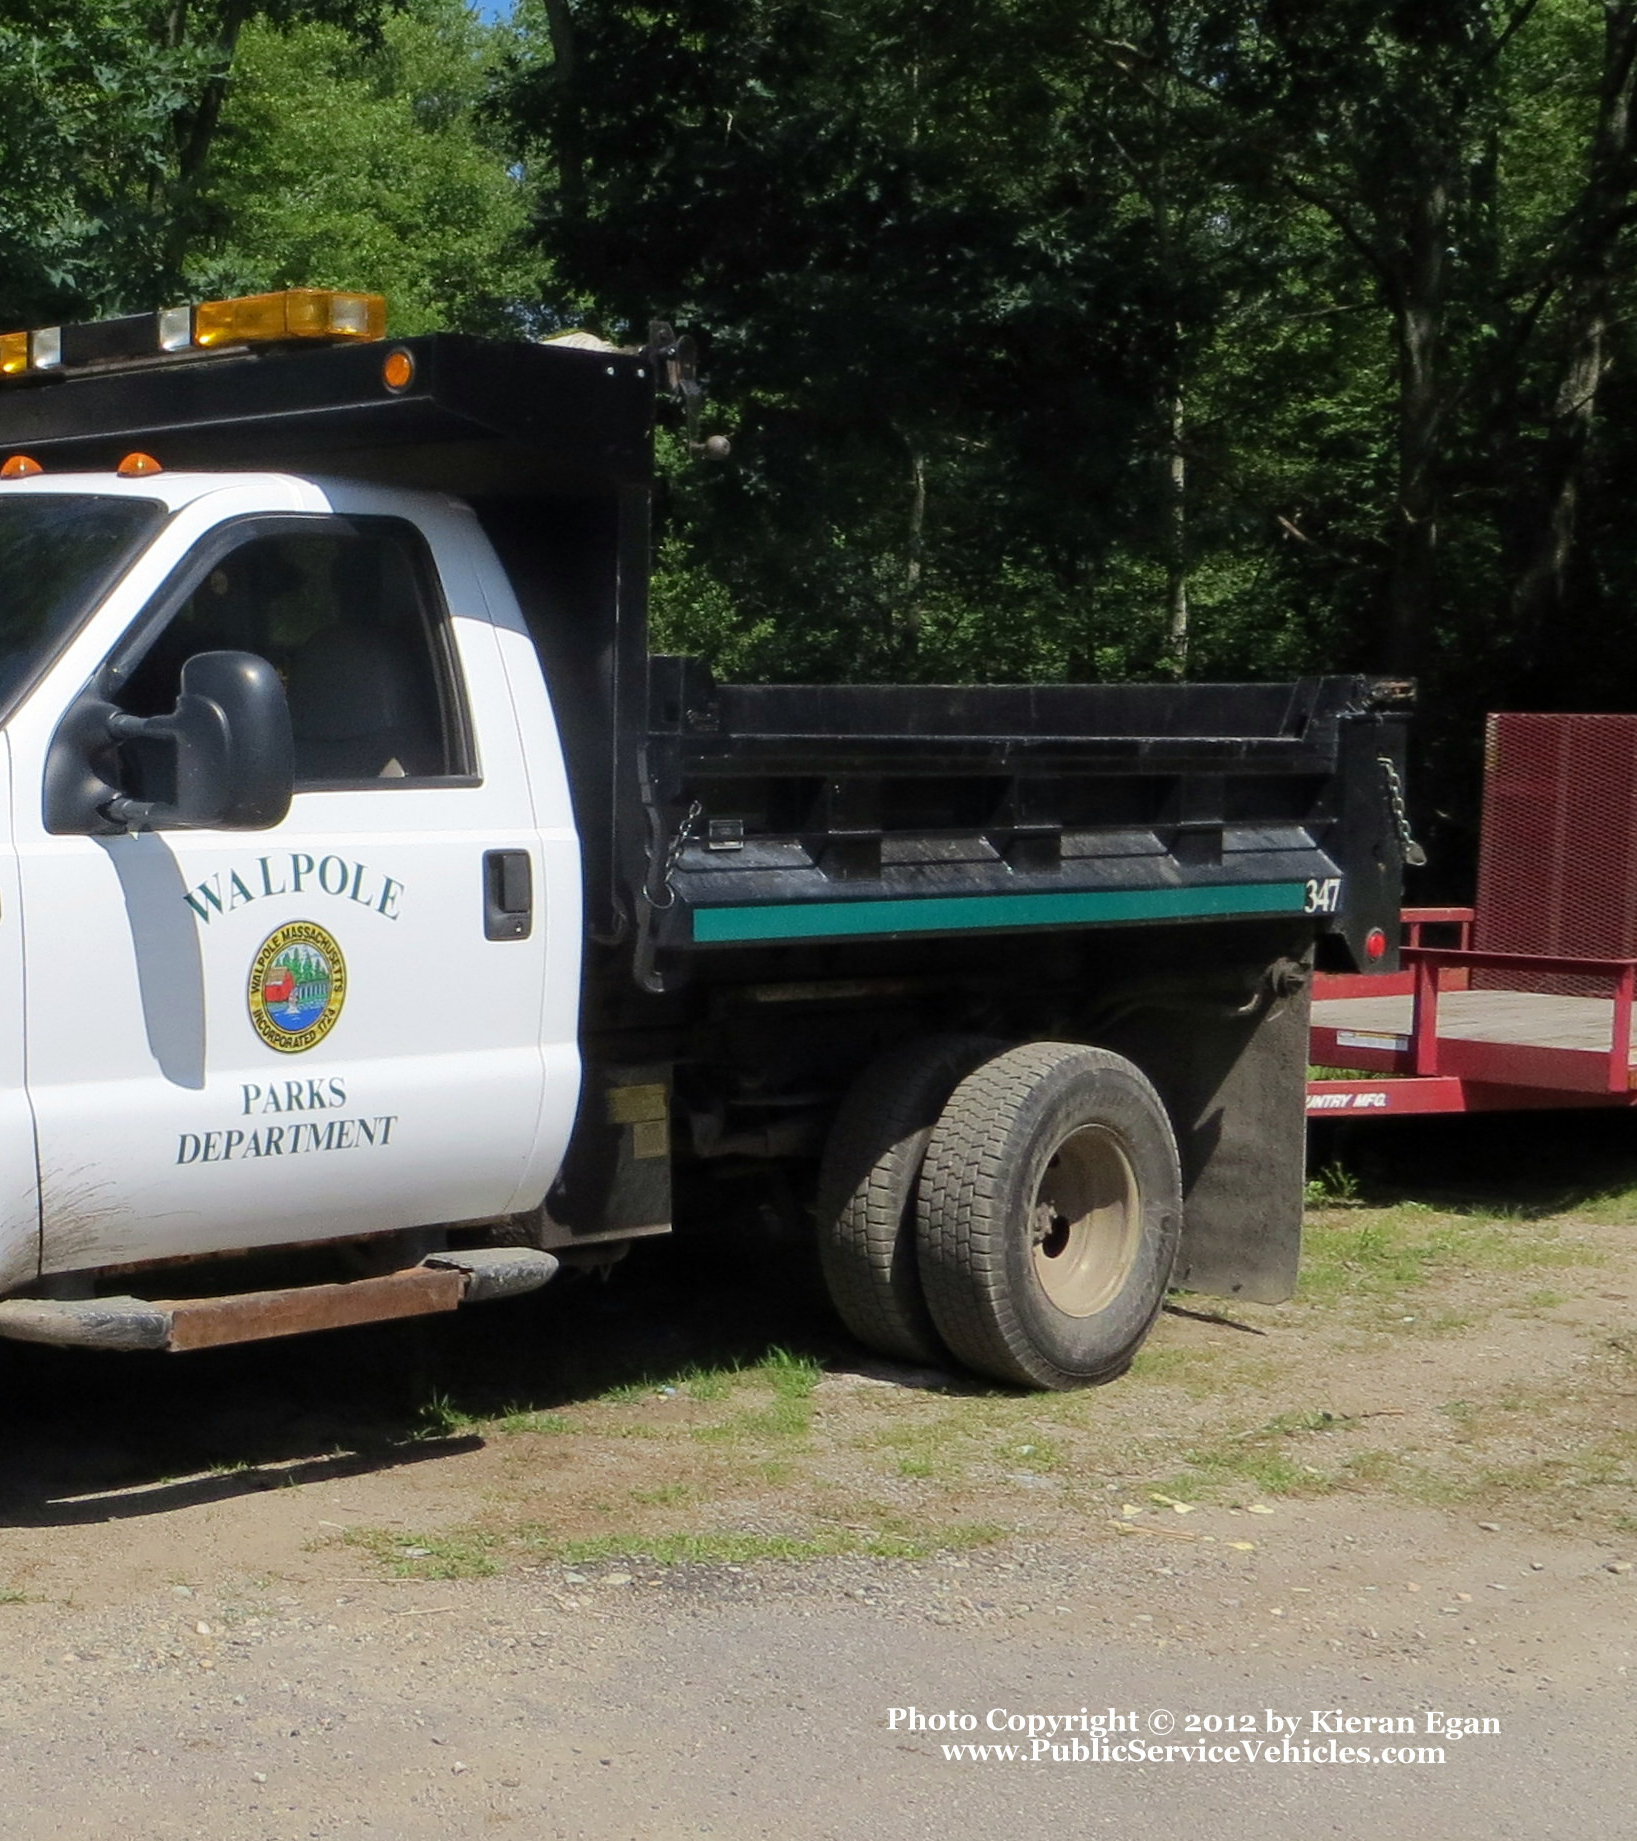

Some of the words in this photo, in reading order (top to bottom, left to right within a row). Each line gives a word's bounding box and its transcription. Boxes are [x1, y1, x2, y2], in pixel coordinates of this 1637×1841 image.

[183, 852, 406, 926] WALPOLE
[1304, 878, 1341, 913] 347
[250, 936, 281, 995] WALPOLE
[281, 925, 344, 993] MASSACHUSETTS
[252, 1009, 317, 1049] INCORPORATED
[318, 1008, 336, 1034] 1724
[240, 1076, 348, 1116] PARKS
[175, 1115, 399, 1166] DEPARTMENT
